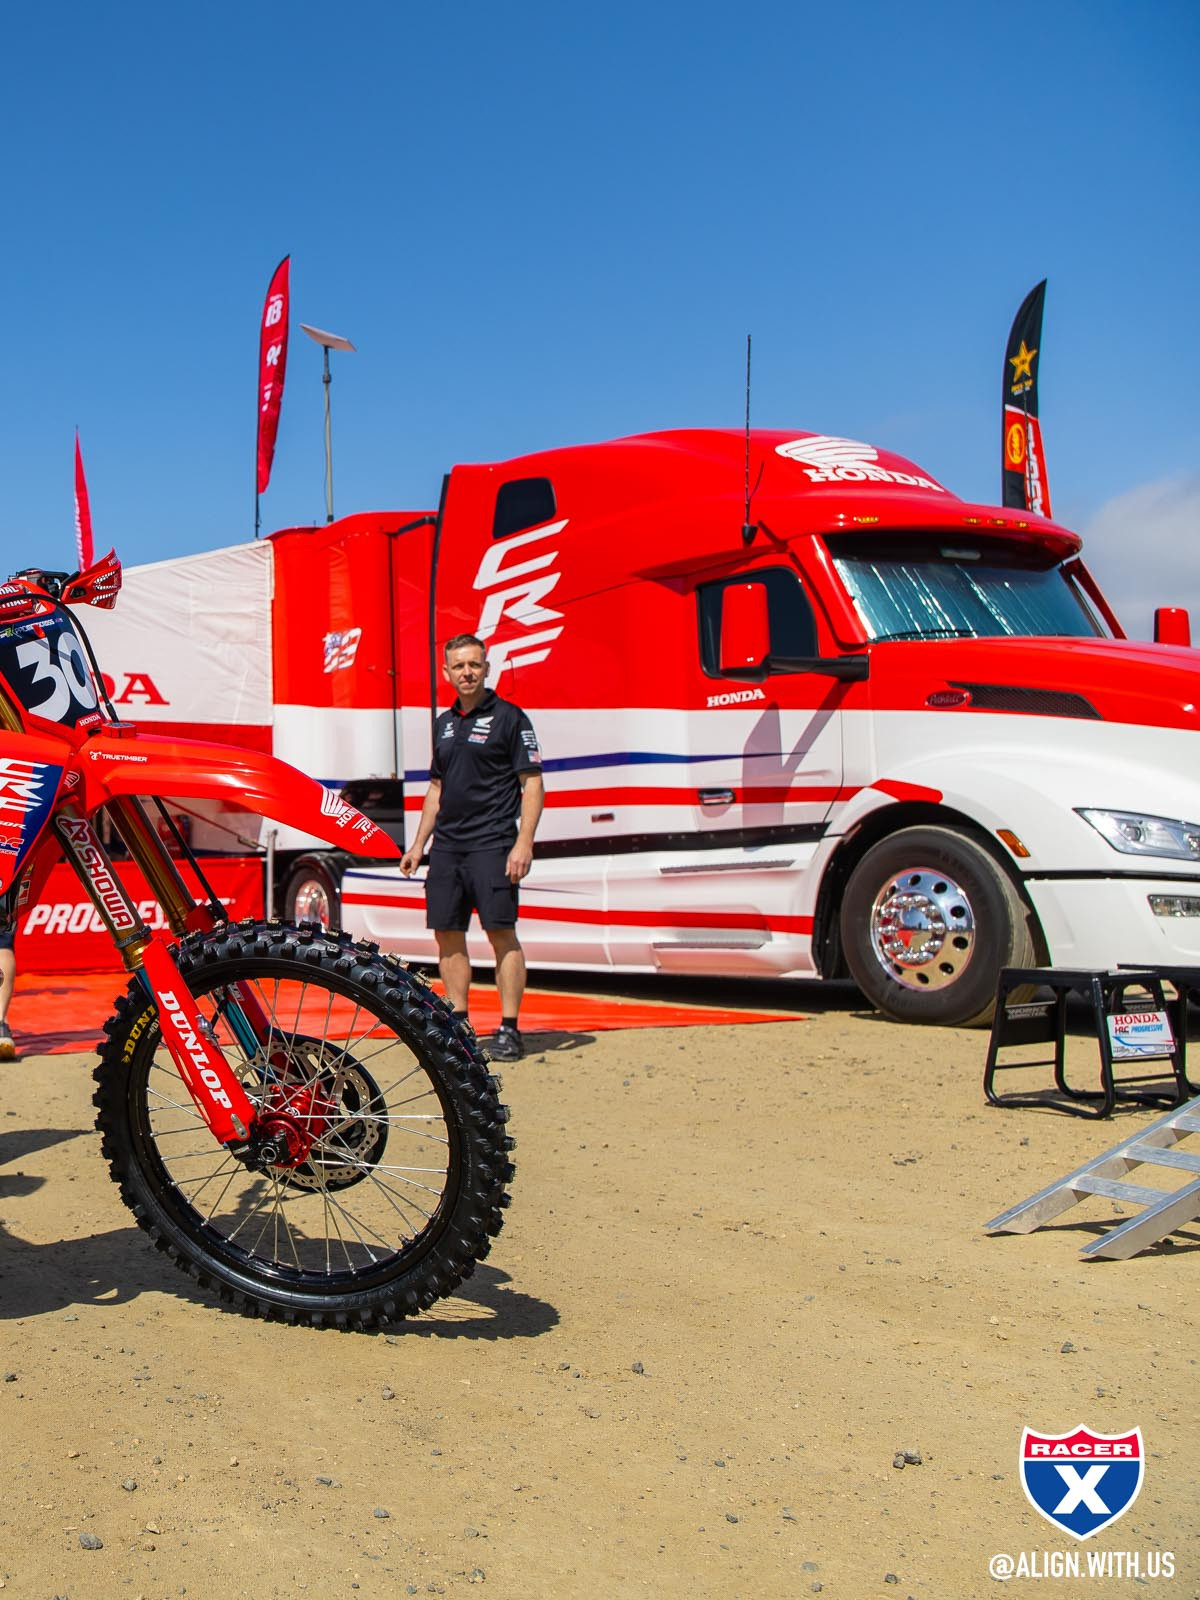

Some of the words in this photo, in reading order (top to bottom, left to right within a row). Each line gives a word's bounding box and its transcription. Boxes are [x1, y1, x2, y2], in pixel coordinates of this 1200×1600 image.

[802, 468, 945, 493] HONDA
[15, 631, 98, 723] 30
[706, 688, 766, 707] HONDA
[79, 713, 101, 727] HONDA
[74, 845, 136, 931] SHOWA
[1114, 1013, 1161, 1026] HONDA
[1131, 1023, 1164, 1034] PROGRESSIVE
[157, 990, 233, 1109] DUNLOP
